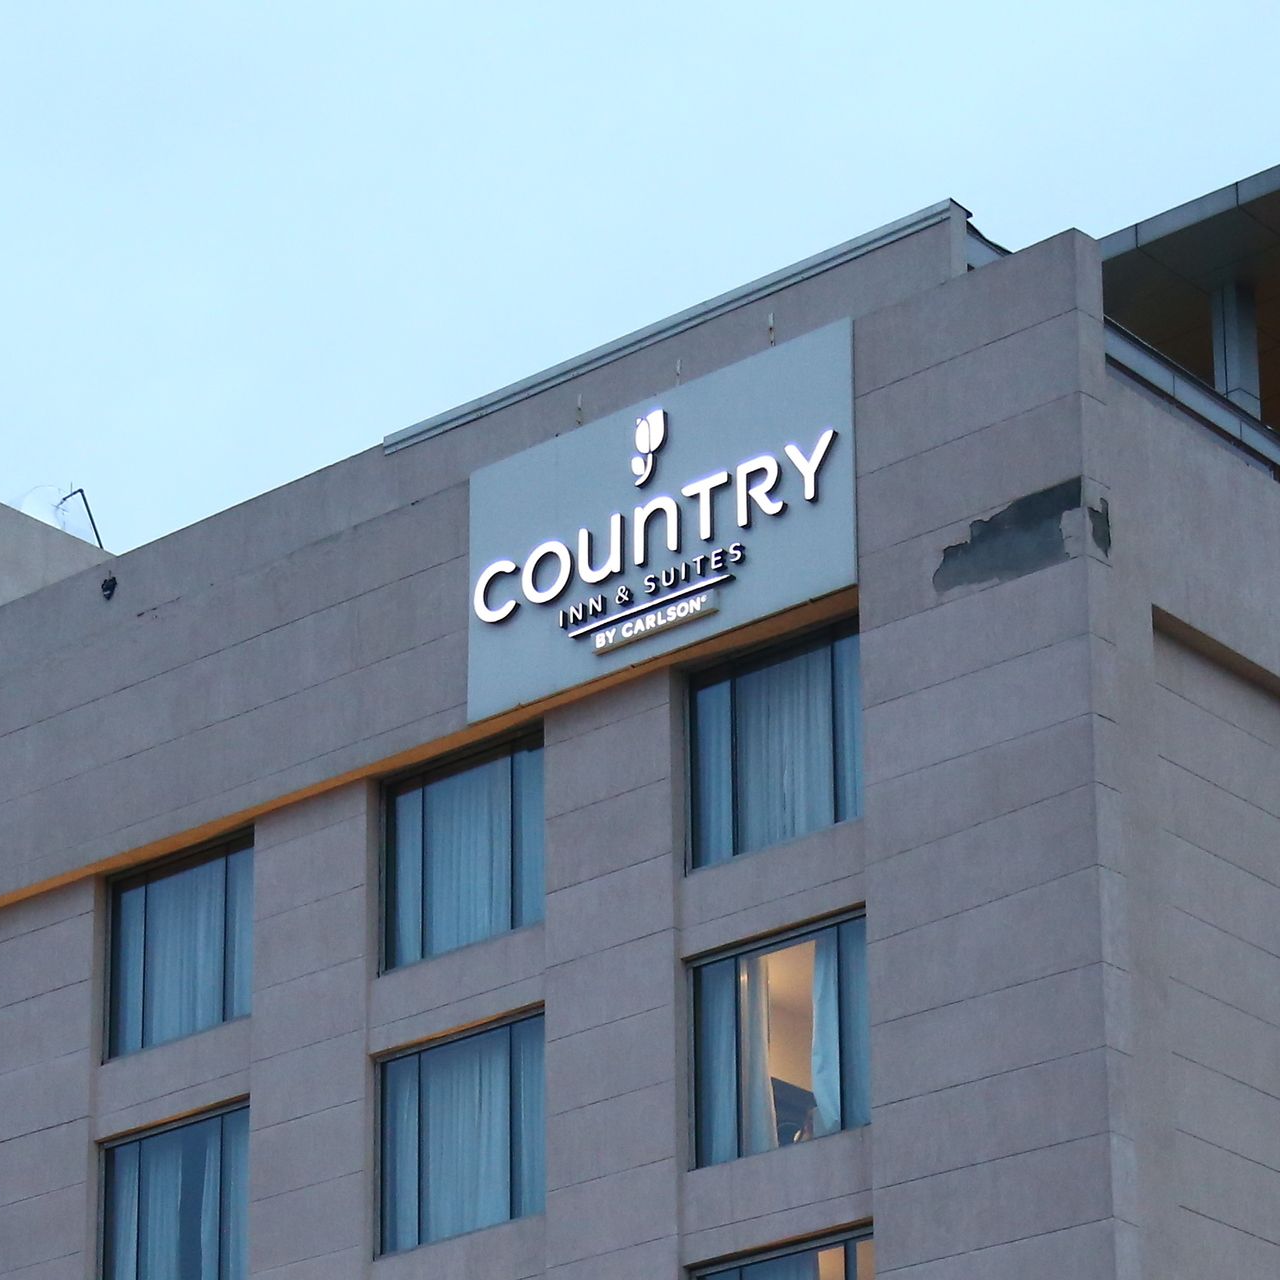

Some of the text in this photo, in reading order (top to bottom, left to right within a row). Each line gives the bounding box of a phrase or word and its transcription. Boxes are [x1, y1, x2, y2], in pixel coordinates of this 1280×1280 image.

[559, 542, 744, 629] INN & SUITES
[595, 628, 617, 649] BY
